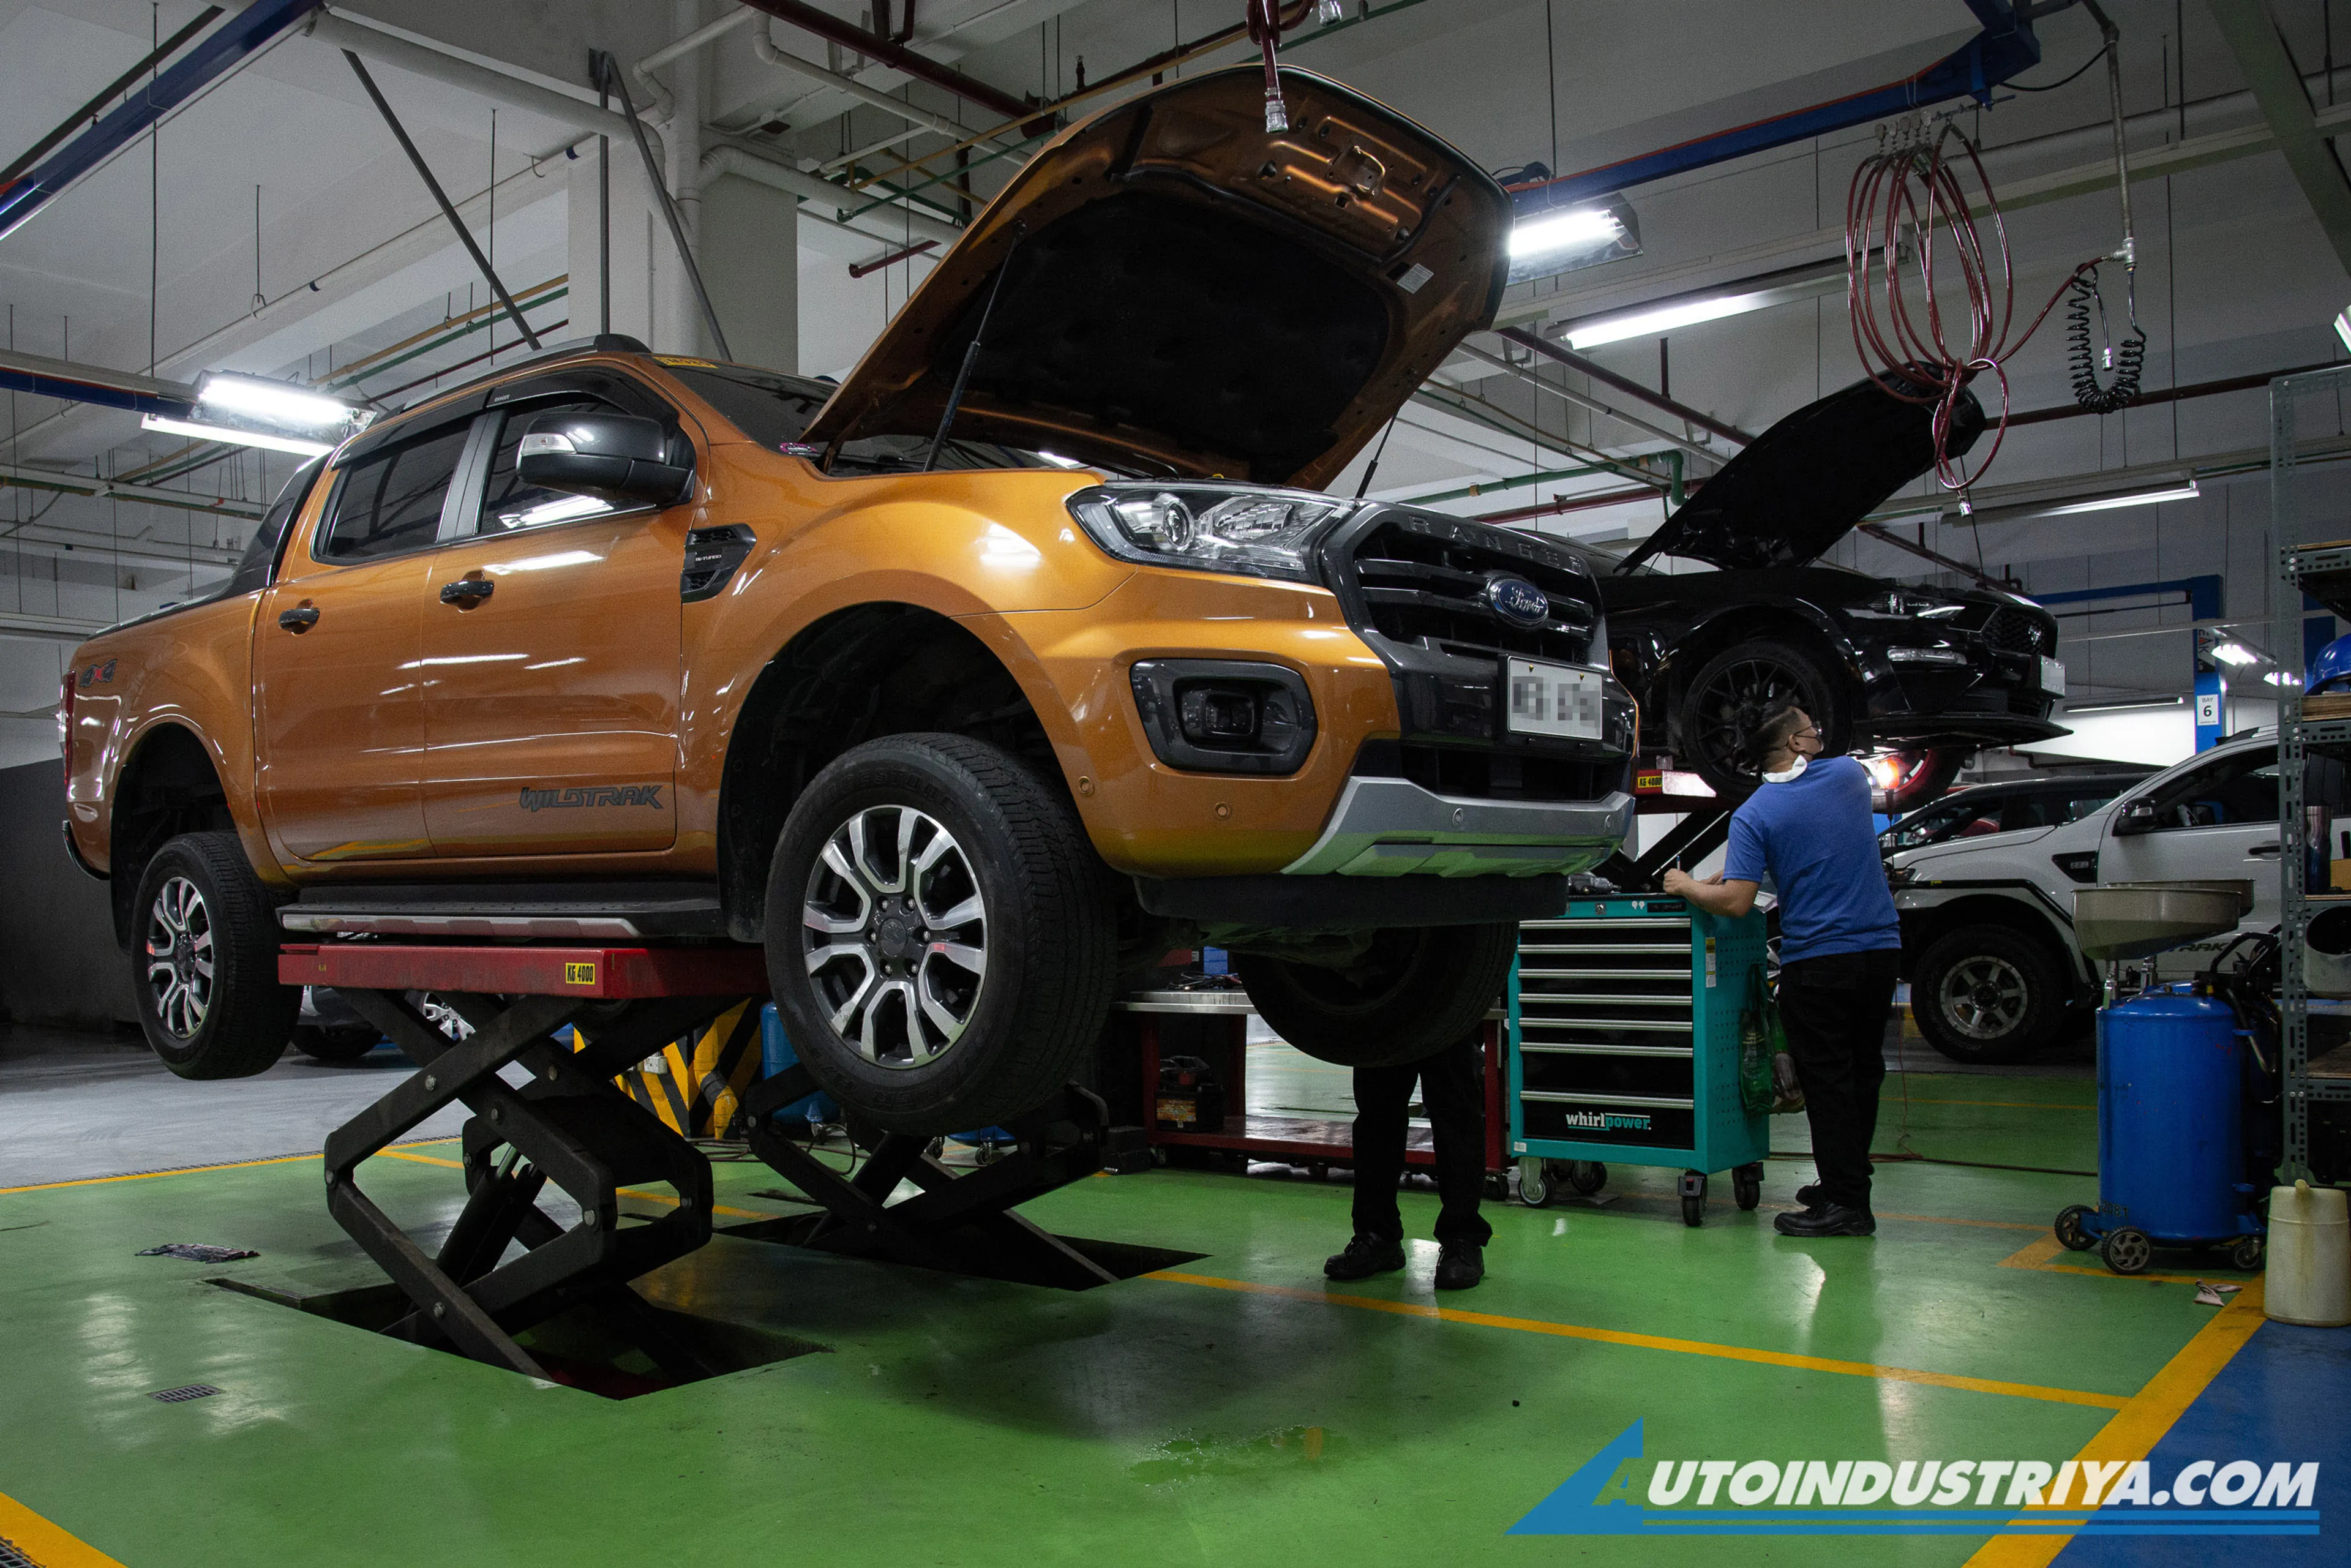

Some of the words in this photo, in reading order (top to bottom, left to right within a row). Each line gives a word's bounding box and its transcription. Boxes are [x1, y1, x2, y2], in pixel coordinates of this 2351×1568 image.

[1409, 515, 1583, 574] RANGER
[1504, 585, 1543, 612] Ford
[2203, 705, 2212, 717] 6
[520, 786, 664, 812] WILDTRAK
[2168, 942, 2229, 952] RAK
[568, 965, 576, 981] KG
[577, 965, 593, 982] 4000
